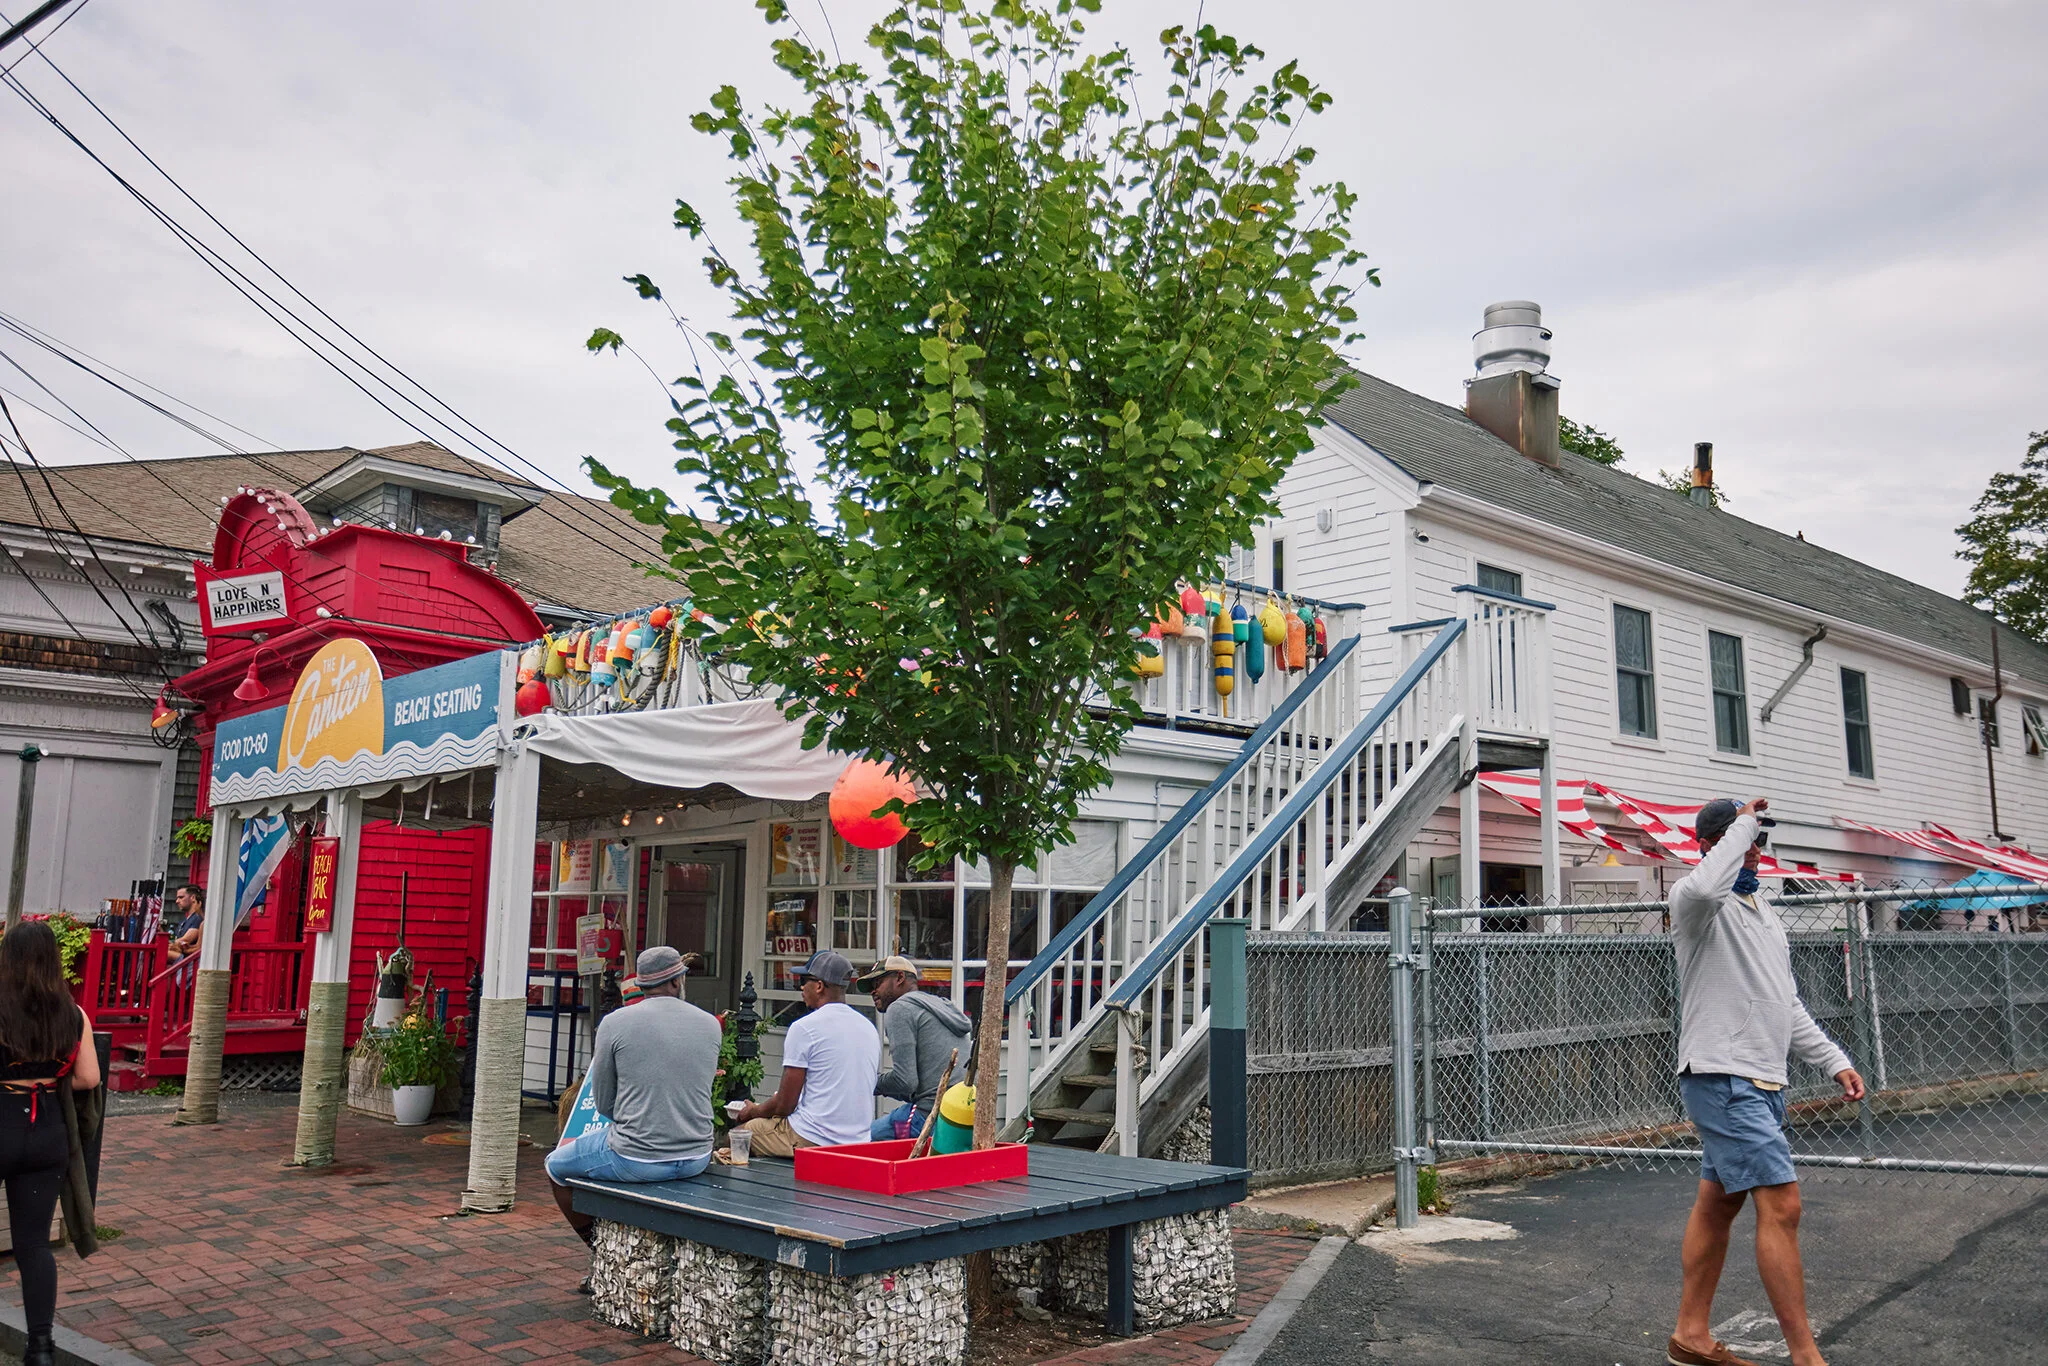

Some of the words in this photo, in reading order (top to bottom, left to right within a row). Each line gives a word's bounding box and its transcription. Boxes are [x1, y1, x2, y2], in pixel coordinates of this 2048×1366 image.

[217, 587, 248, 602] LOVE
[261, 583, 269, 596] N
[213, 598, 281, 618] HAPPINESS
[323, 656, 337, 674] THE
[287, 653, 372, 765] Canteen
[394, 695, 431, 727] BEACH
[432, 683, 482, 719] SEATING
[221, 737, 241, 761] FOOD
[243, 732, 268, 757] TO-GO
[313, 854, 333, 875] BEACH
[312, 875, 328, 900] BAR
[777, 937, 809, 953] OPEN
